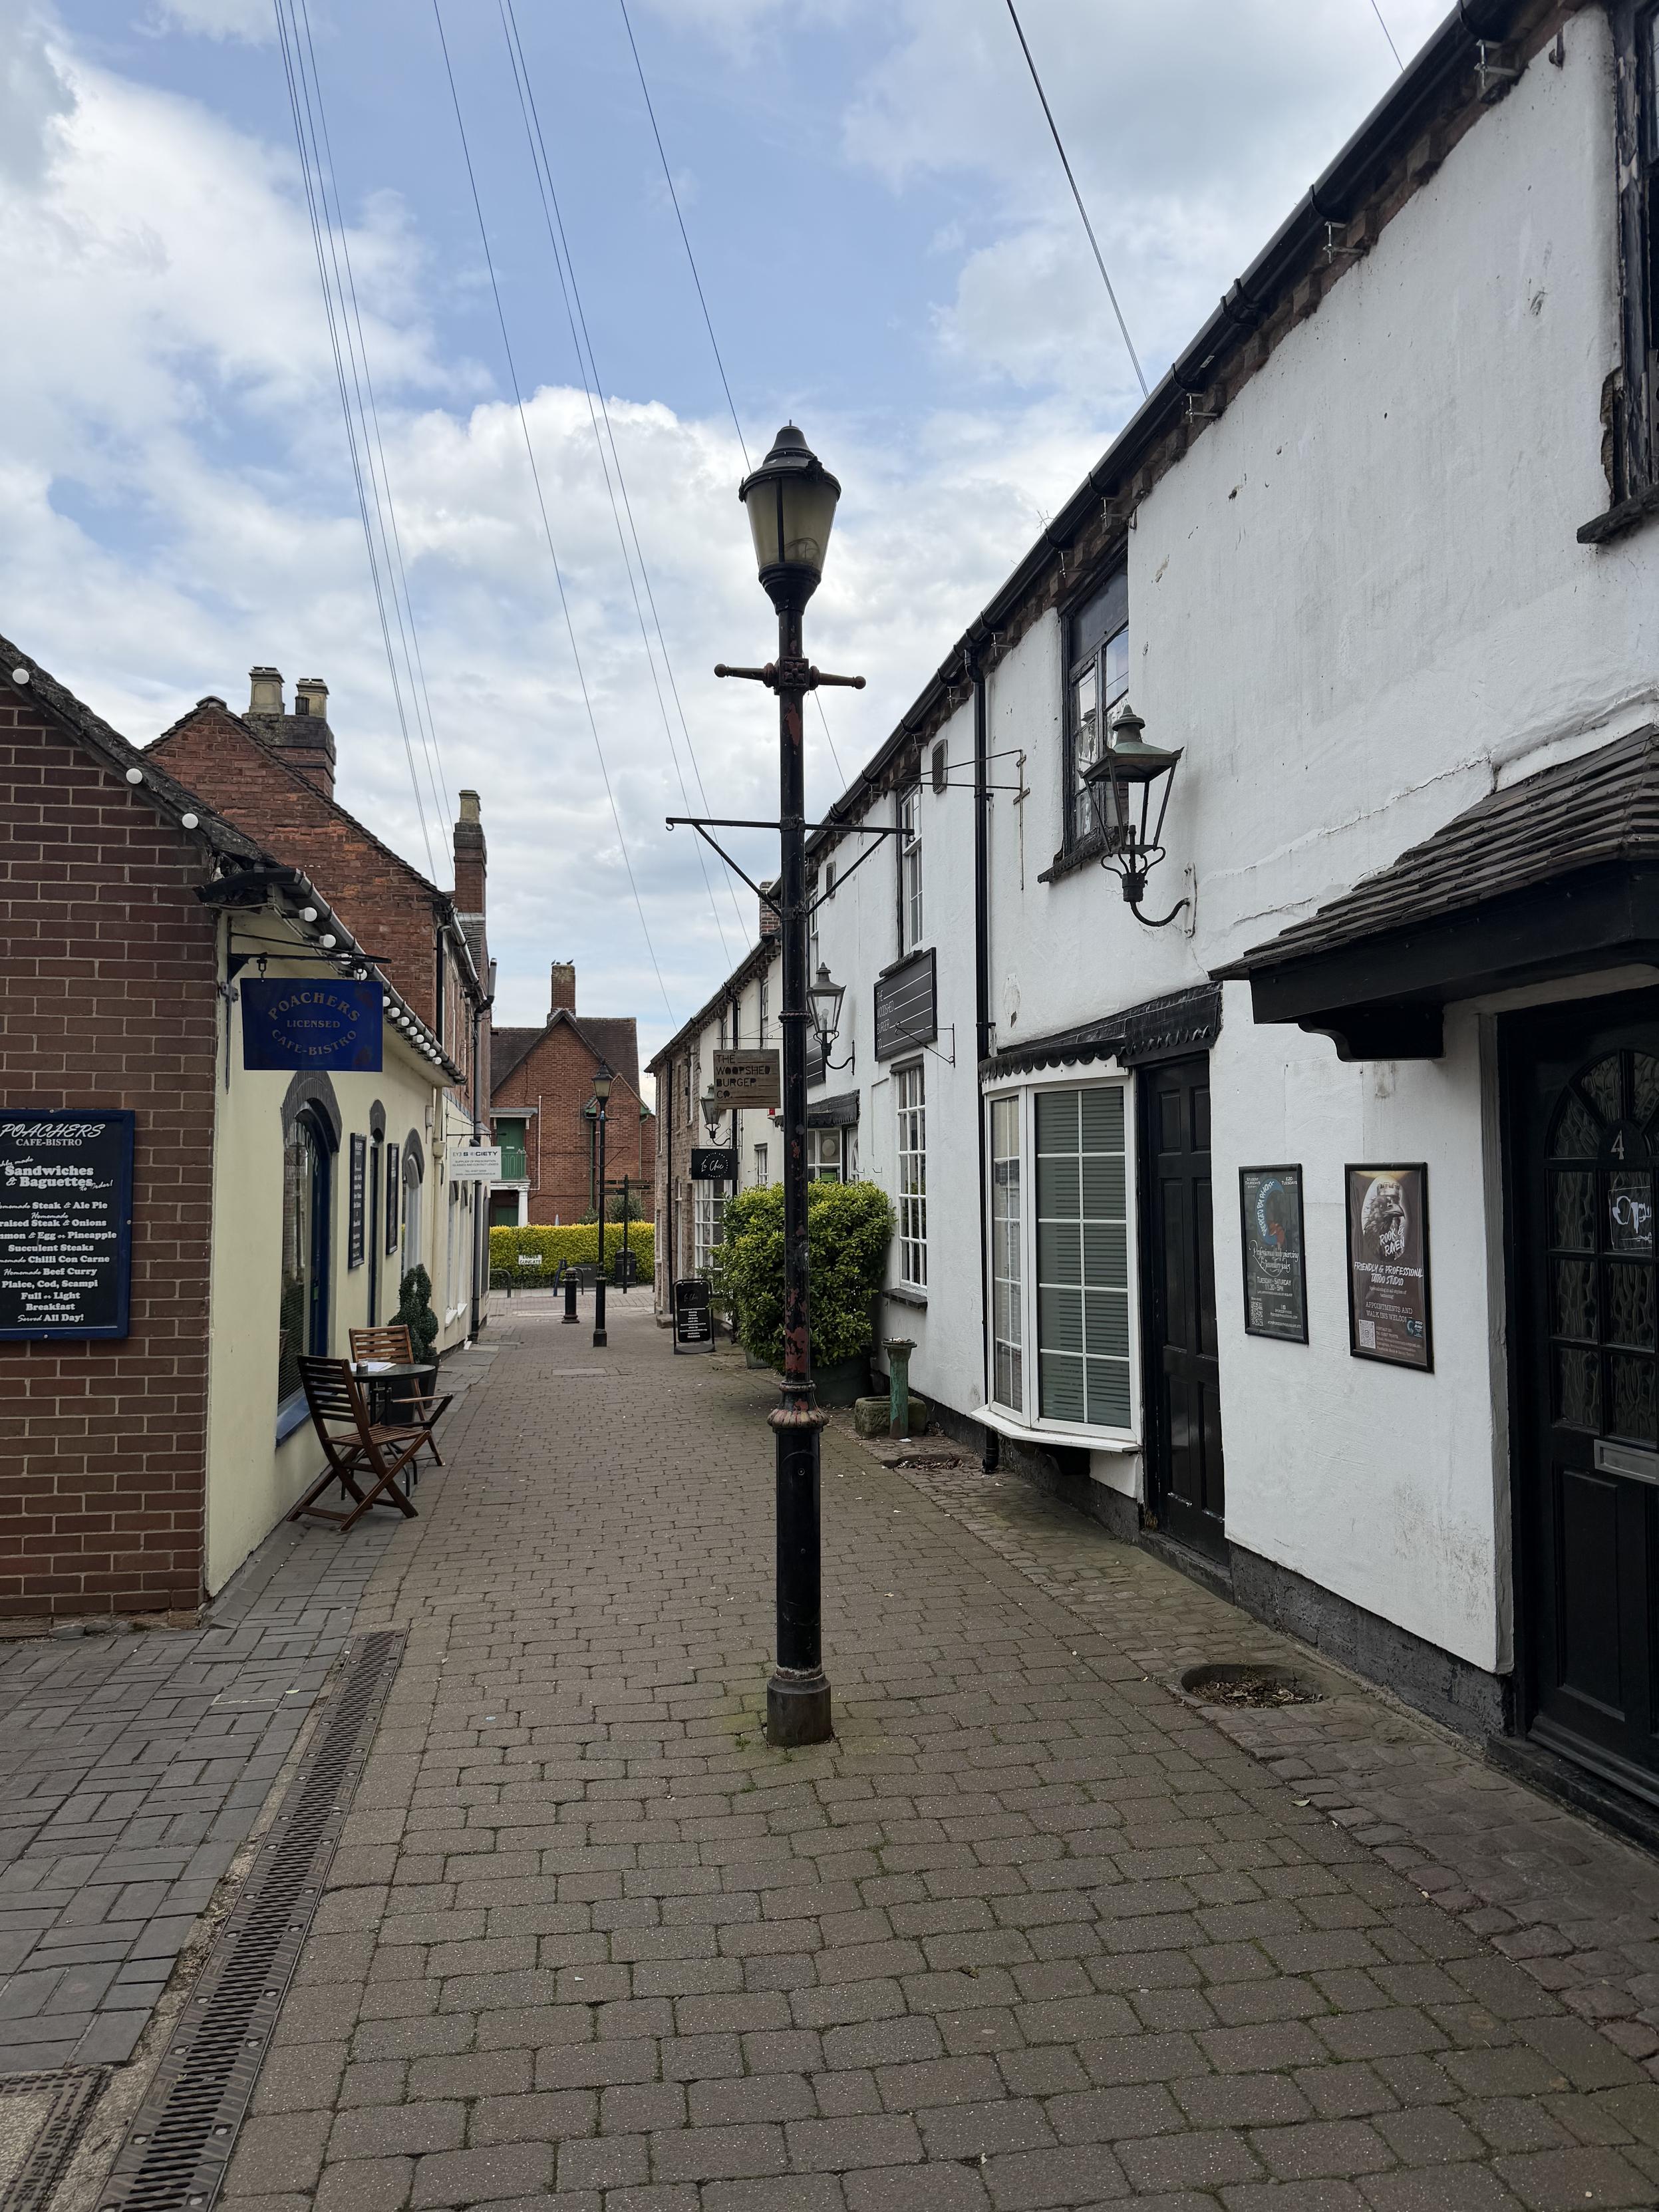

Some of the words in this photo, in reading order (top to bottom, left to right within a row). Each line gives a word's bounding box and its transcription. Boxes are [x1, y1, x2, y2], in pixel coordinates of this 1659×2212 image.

[267, 992, 360, 1021] POACHERS
[287, 1020, 341, 1028] LICENSED
[272, 1029, 357, 1056] CAFE-BISTRO
[716, 1054, 735, 1063] THE
[0, 1123, 106, 1138] POACHERS
[1610, 1129, 1624, 1160] 4
[14, 1156, 34, 1165] made
[709, 1160, 724, 1171] Chic
[5, 1165, 94, 1176] Sandwiches
[6, 1177, 17, 1186] &
[19, 1176, 93, 1189] Baguettes
[37, 1231, 56, 1241] Egg
[67, 1231, 117, 1240] Pineapple
[1379, 1228, 1397, 1246] ROOK
[1384, 1236, 1405, 1256] RAVEN
[67, 1268, 98, 1276] Curry
[1354, 1262, 1378, 1273] FRIENDLY
[1385, 1265, 1424, 1278] PROFESSIONAL
[2, 1280, 35, 1289] Plaice,
[37, 1280, 60, 1289] Cod,
[62, 1279, 98, 1288] Scampi
[1371, 1273, 1385, 1284] TATTOO
[1386, 1275, 1404, 1286] STUDIO
[53, 1292, 81, 1301] Light
[1366, 1302, 1401, 1313] APPOINTMENTS
[61, 1314, 84, 1323] Day!
